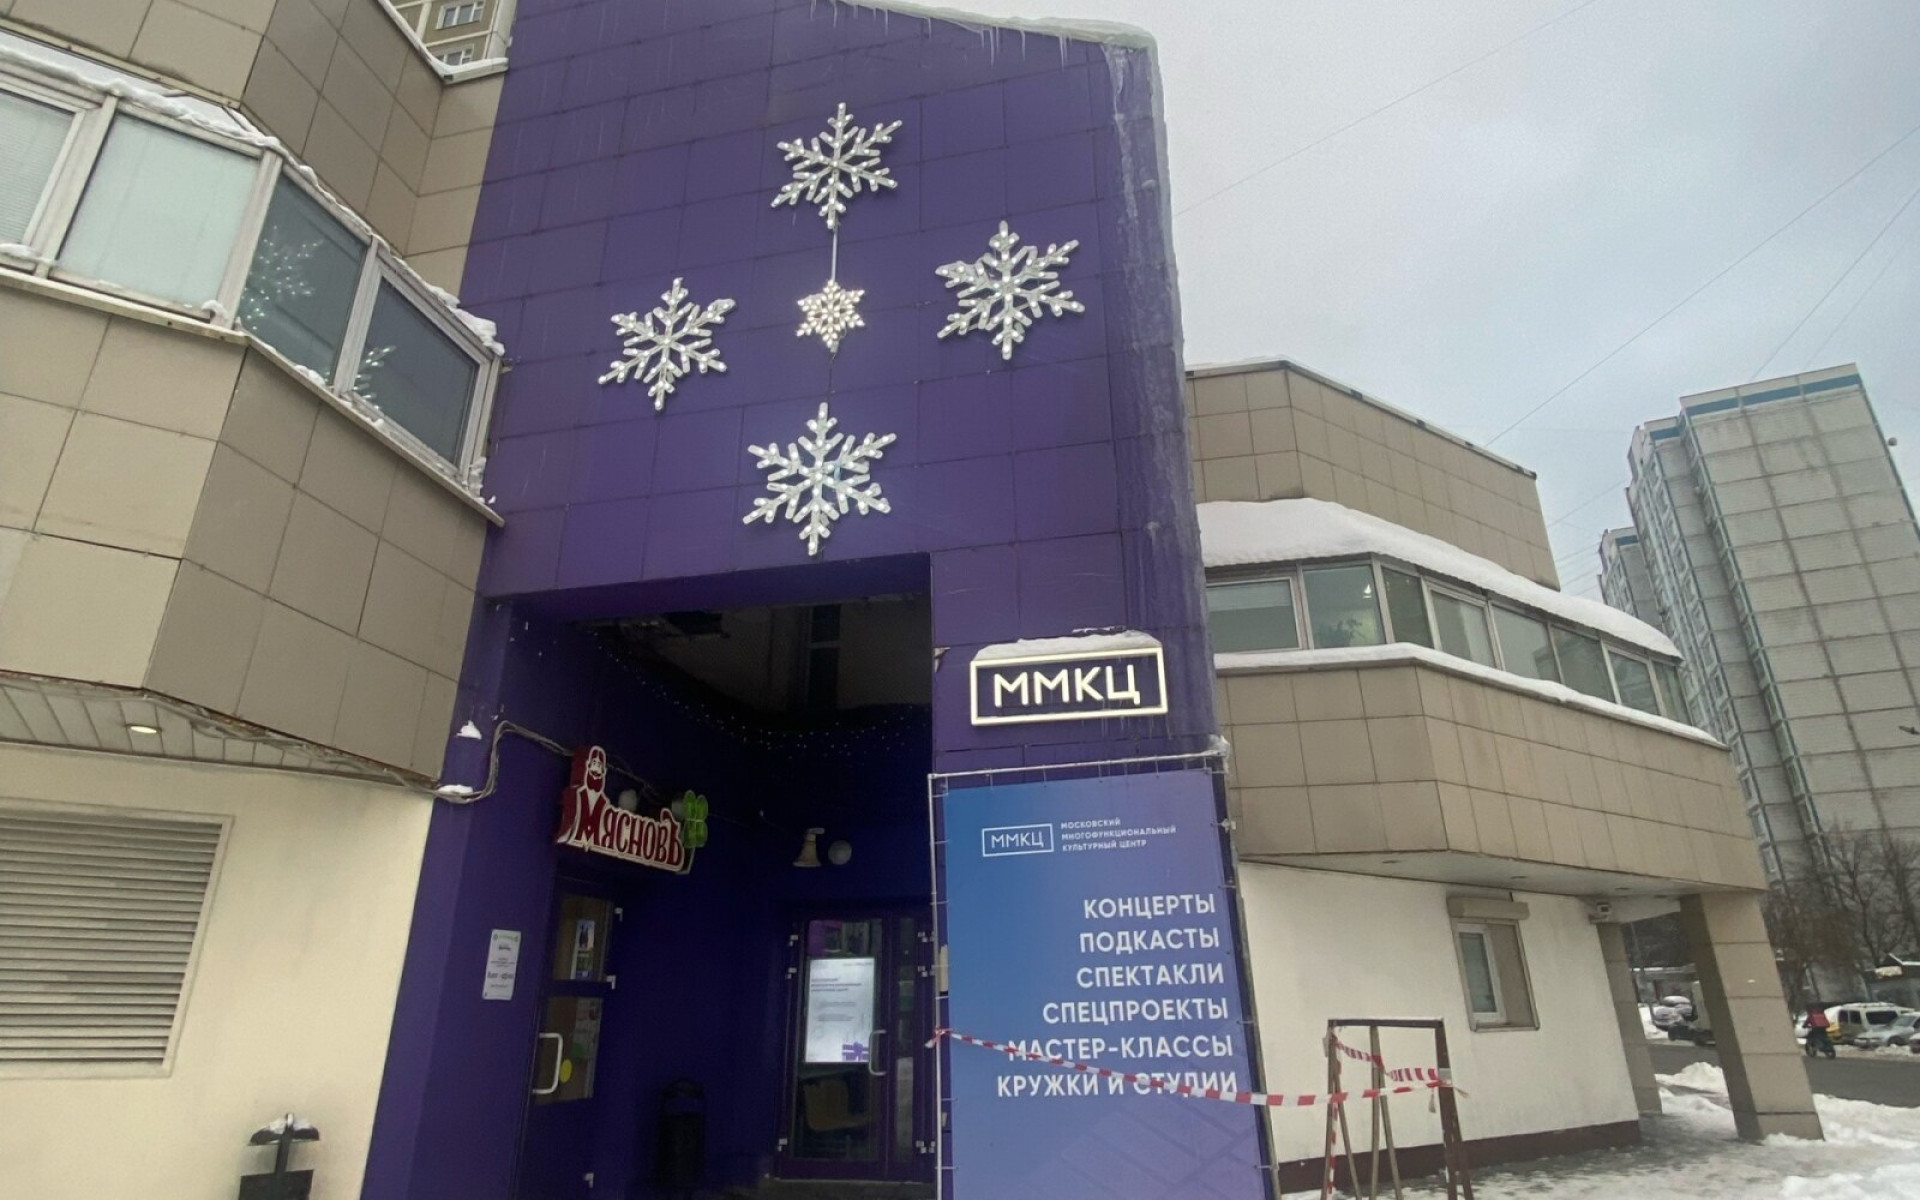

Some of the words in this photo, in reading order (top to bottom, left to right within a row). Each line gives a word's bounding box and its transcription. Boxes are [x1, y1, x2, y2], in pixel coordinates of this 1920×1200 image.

[994, 664, 1141, 707] ММКЦ
[1060, 817, 1121, 830] МОСКОВСКИЙ
[1061, 825, 1177, 841] МНОГОФУНКЦИОНАЛЬНЫЙ
[991, 831, 1045, 849] ММКЦ
[1062, 840, 1117, 852] КУЛЬТУРНЫЙ
[1119, 839, 1147, 848] ЦЕНТР
[1084, 893, 1216, 919] КОНЦЕРТЫ
[1079, 927, 1220, 955] ПОДКАСТЫ
[1076, 962, 1225, 989] СПЕКТАКЛИ
[1042, 998, 1229, 1026] СПЕЦПРОЕКТЫ
[1008, 1035, 1234, 1062] МАСТЕР-КЛАССЫ
[997, 1074, 1099, 1098] КРУЖКИ
[1108, 1074, 1125, 1096] И
